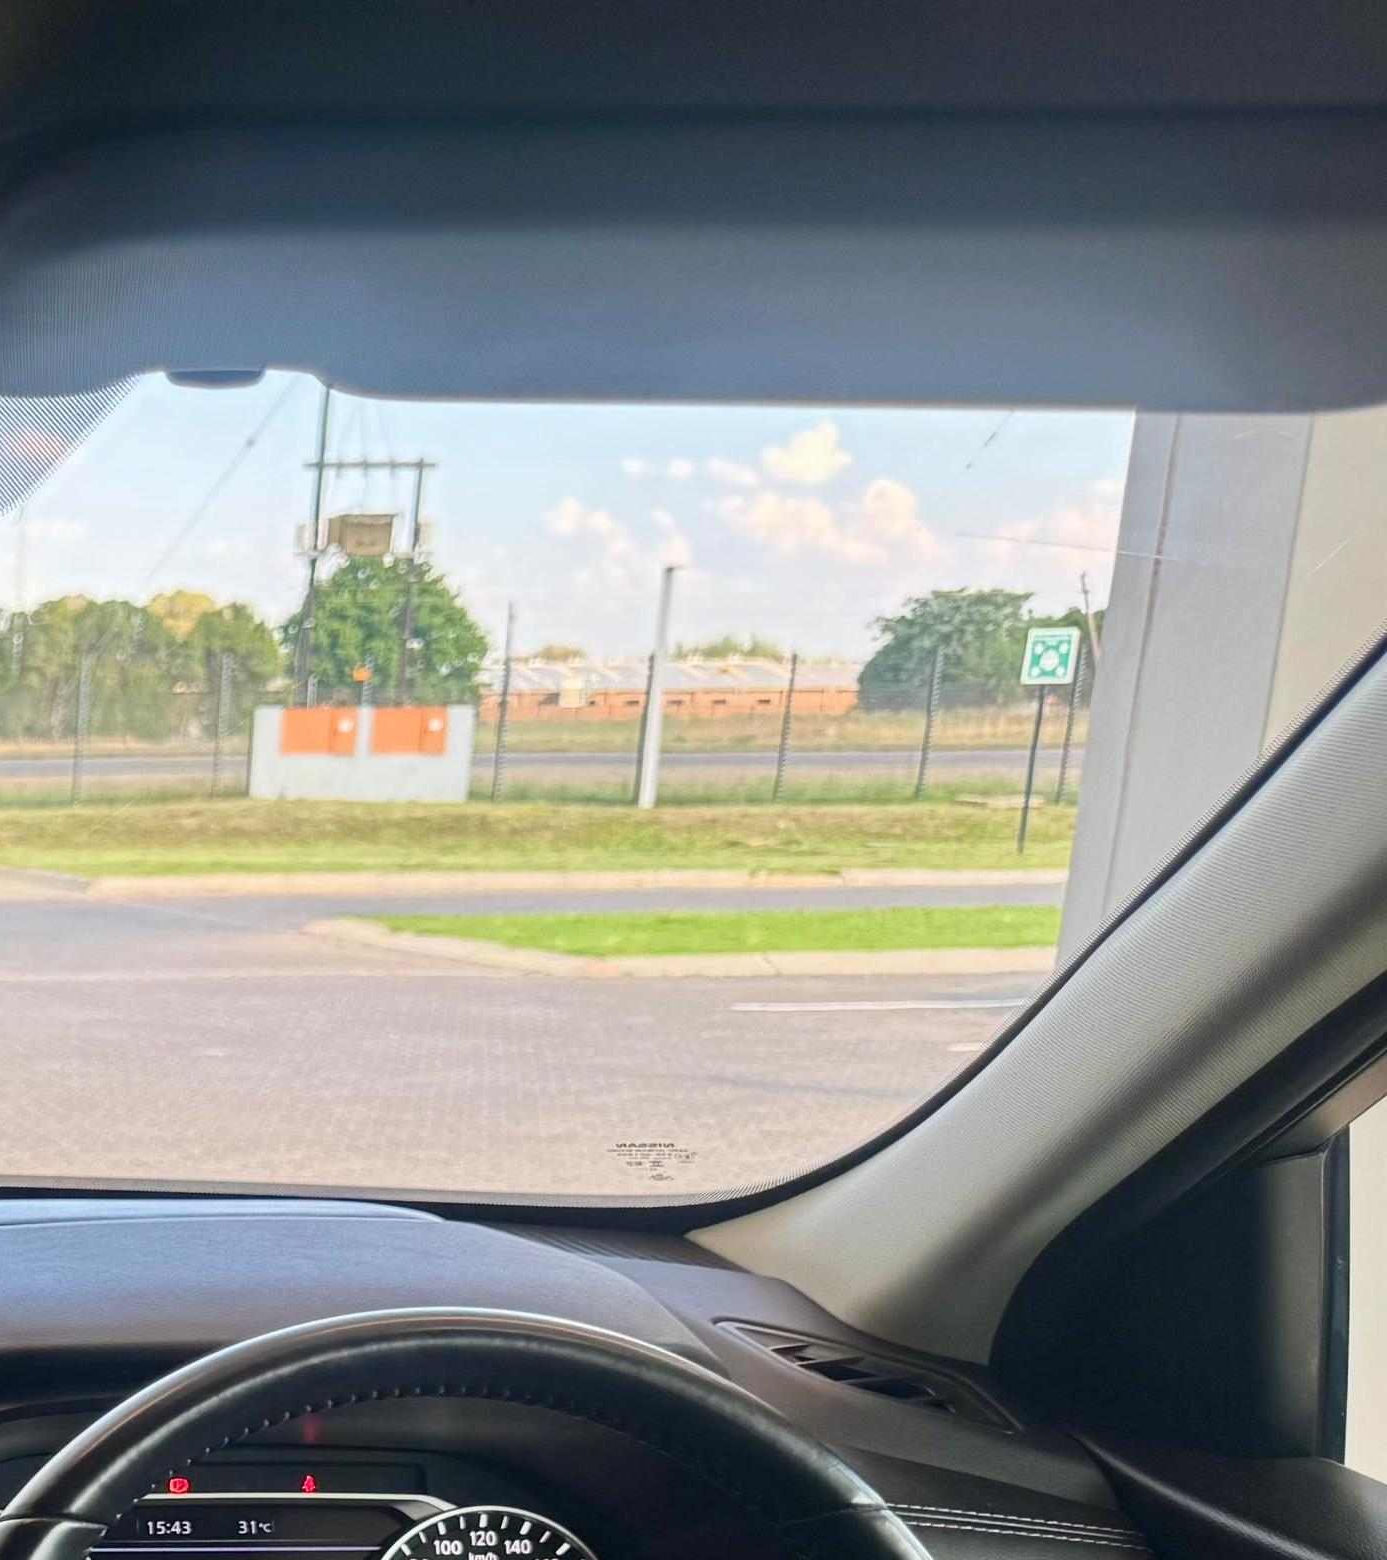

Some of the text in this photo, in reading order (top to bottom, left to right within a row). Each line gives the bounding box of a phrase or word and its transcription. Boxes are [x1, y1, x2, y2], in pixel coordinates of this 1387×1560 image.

[146, 1520, 192, 1535] 15:43
[469, 1530, 497, 1546] 120
[433, 1540, 463, 1556] 100
[504, 1539, 532, 1555] 140
